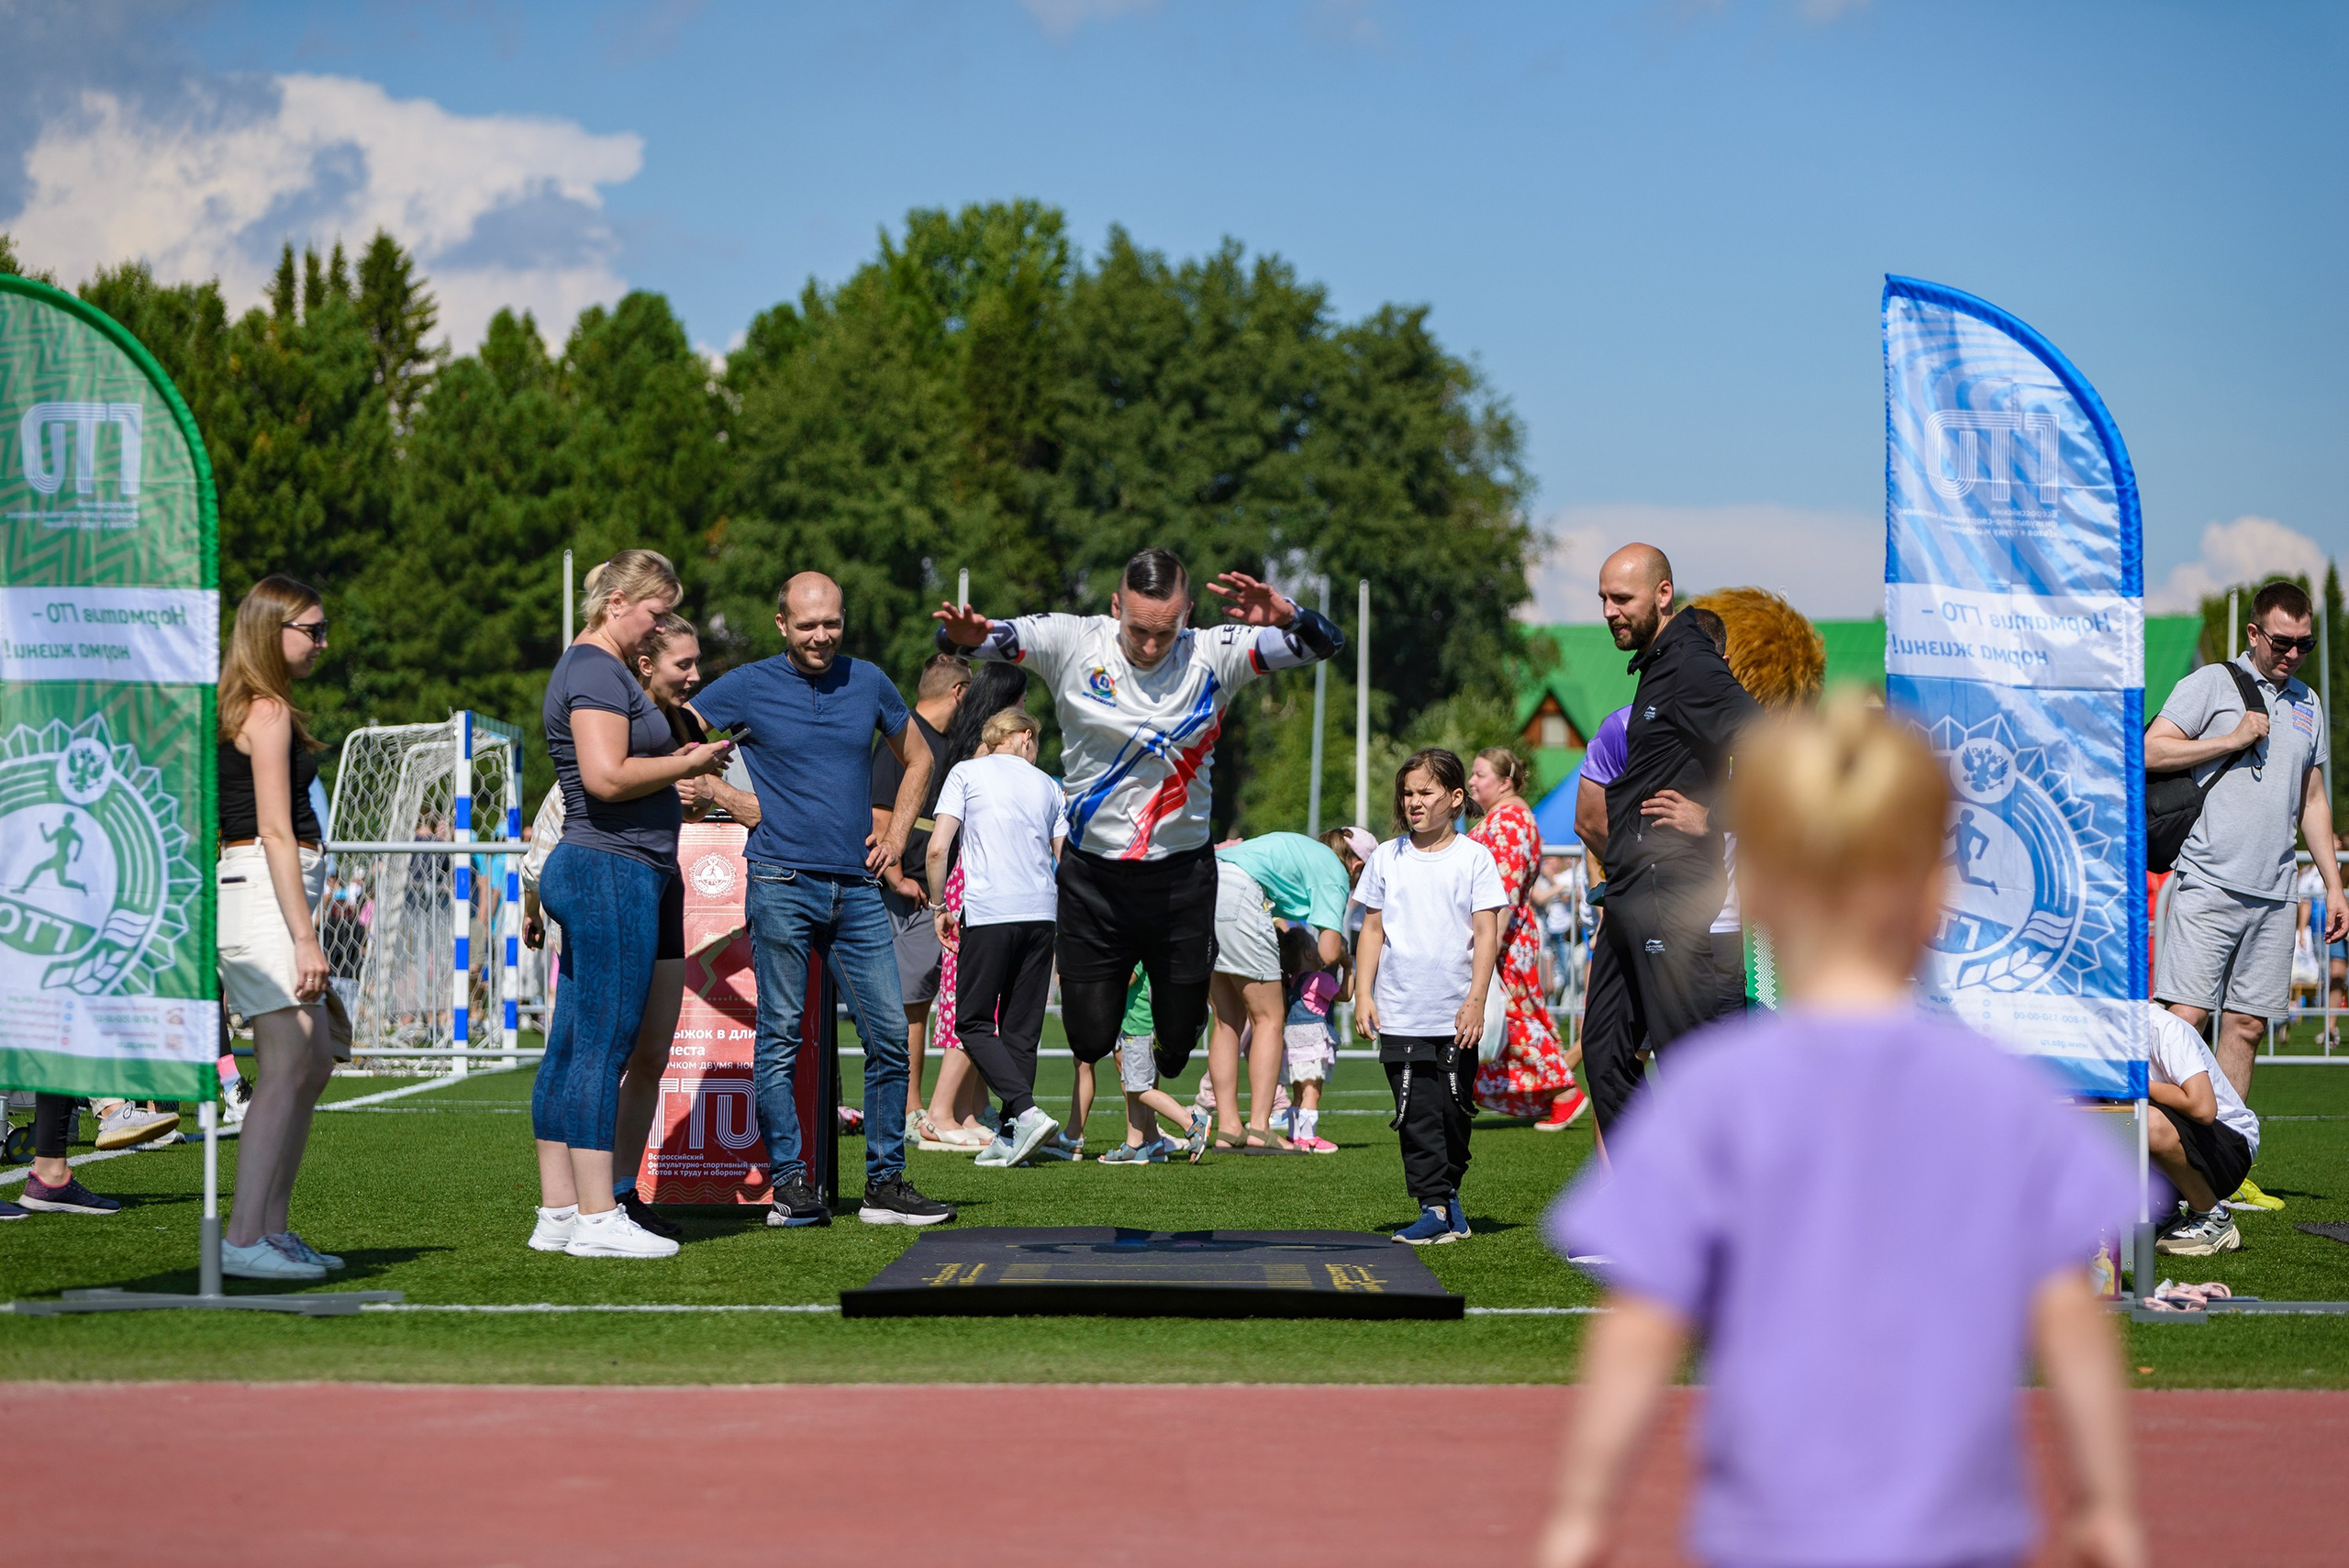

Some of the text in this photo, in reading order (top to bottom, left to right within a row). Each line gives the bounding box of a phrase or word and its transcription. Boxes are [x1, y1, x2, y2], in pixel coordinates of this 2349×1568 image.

[674, 1029, 757, 1040] ыжок в дли
[666, 1062, 754, 1072] чком двумя ног
[648, 1077, 761, 1150] ГТО
[648, 1152, 705, 1161] Всероссийский
[648, 1161, 748, 1170] физкультурно-спортивный
[680, 1169, 702, 1178] труду
